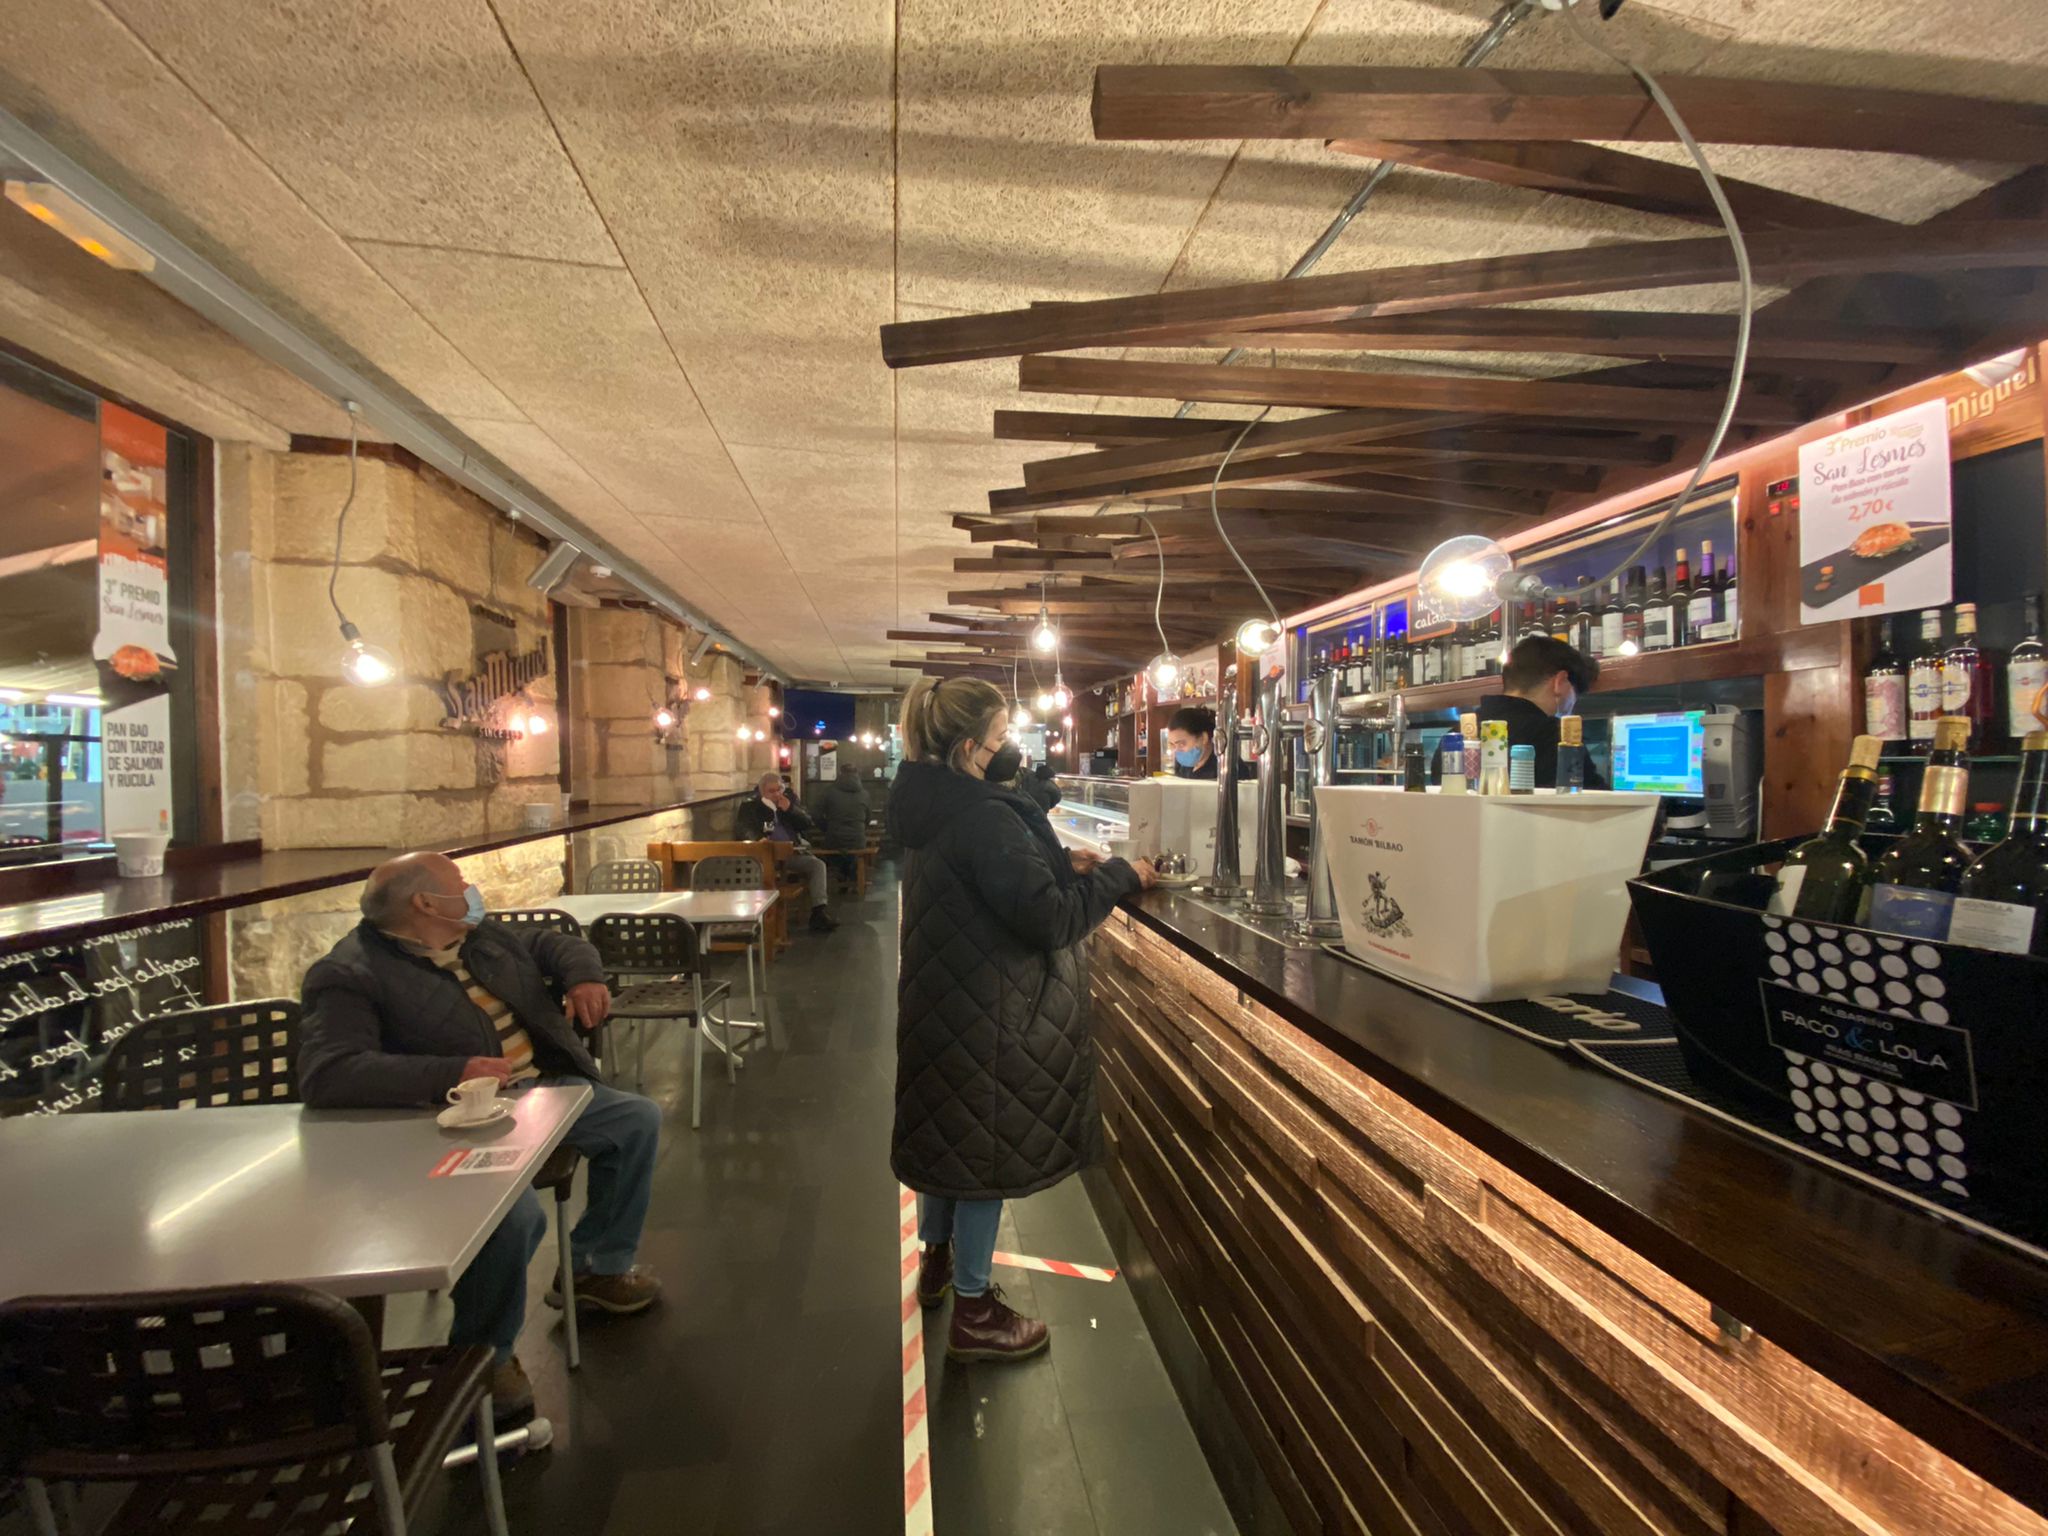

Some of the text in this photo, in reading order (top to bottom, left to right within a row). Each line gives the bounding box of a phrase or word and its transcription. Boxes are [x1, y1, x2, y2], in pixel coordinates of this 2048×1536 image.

[1813, 461, 1849, 487] San
[1856, 438, 1927, 476] Lesmes
[120, 582, 161, 606] PREMIO
[104, 595, 125, 616] San
[439, 667, 489, 730] San
[107, 721, 149, 738] PAN BAO
[107, 739, 165, 755] CON TARTAR
[108, 756, 122, 771] DE
[108, 774, 115, 788] Y
[1374, 839, 1404, 853] BILBAO
[1780, 1010, 1840, 1039] PACO
[1845, 1026, 1873, 1052] &
[1879, 1039, 1949, 1071] LOLA
